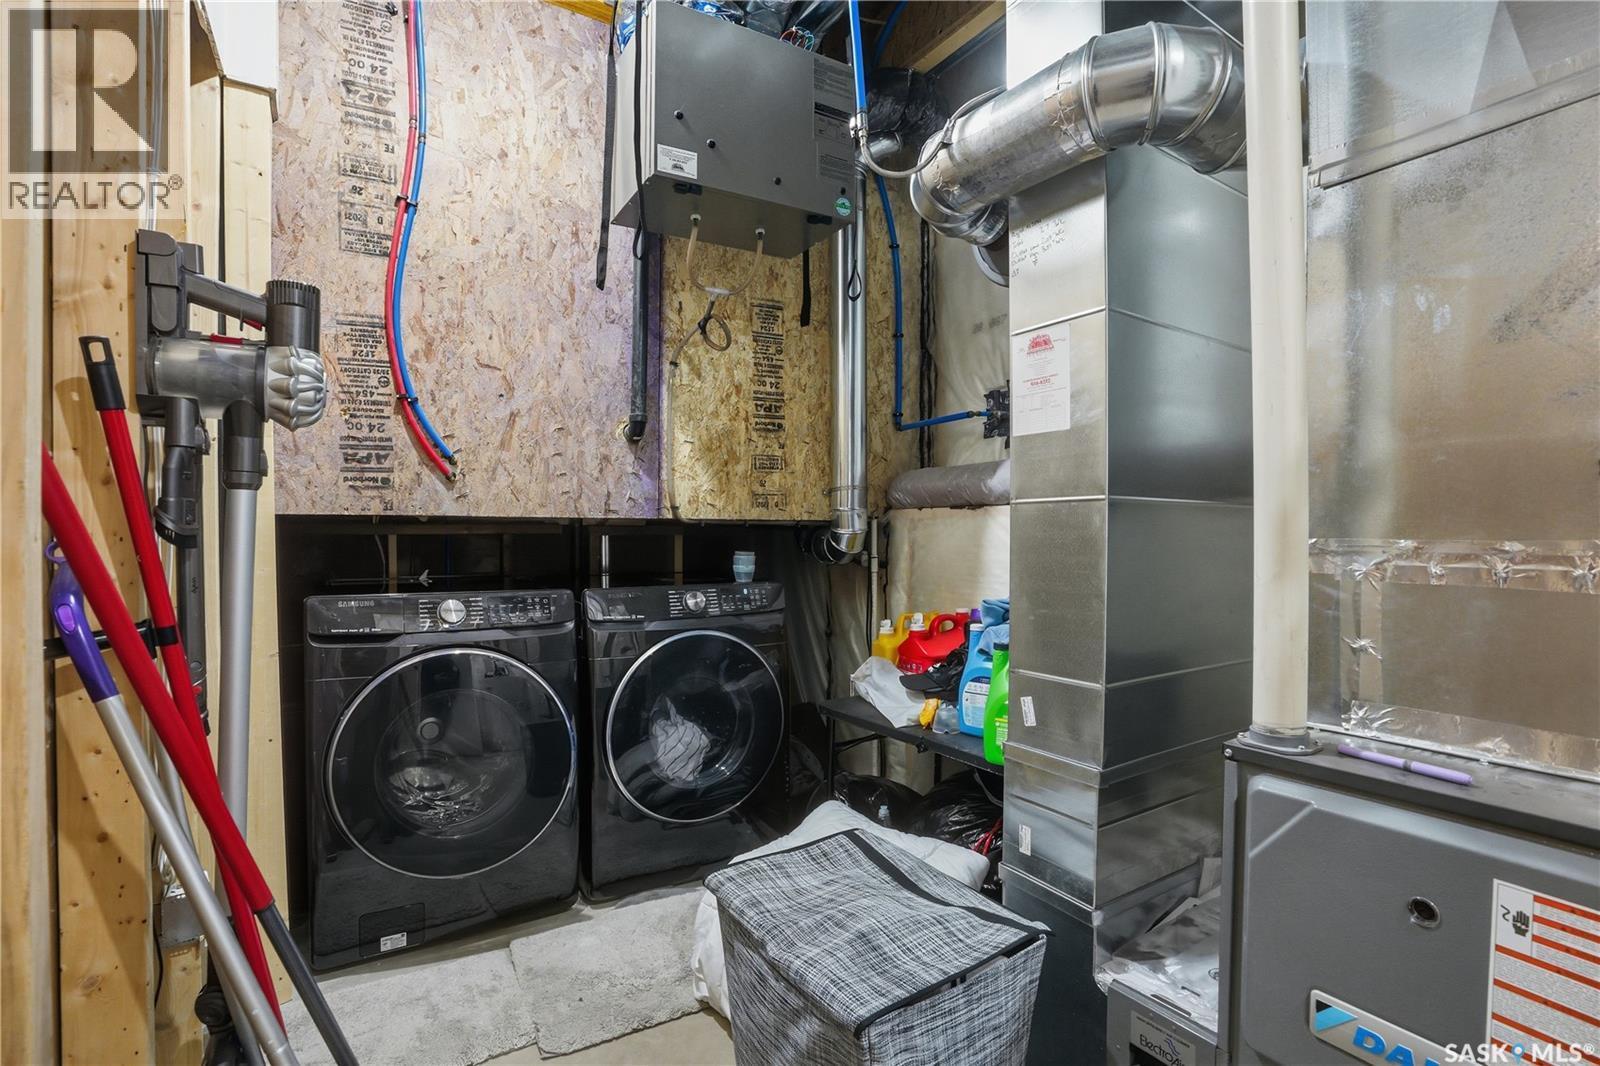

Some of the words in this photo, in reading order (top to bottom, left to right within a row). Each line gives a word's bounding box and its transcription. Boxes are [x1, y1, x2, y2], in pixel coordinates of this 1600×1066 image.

[348, 57, 366, 69] OC
[370, 63, 388, 76] 24
[340, 367, 371, 375] CATEGORY
[355, 389, 375, 398] 454
[347, 421, 364, 431] OC
[367, 422, 386, 433] 24
[343, 476, 379, 484] Norbord
